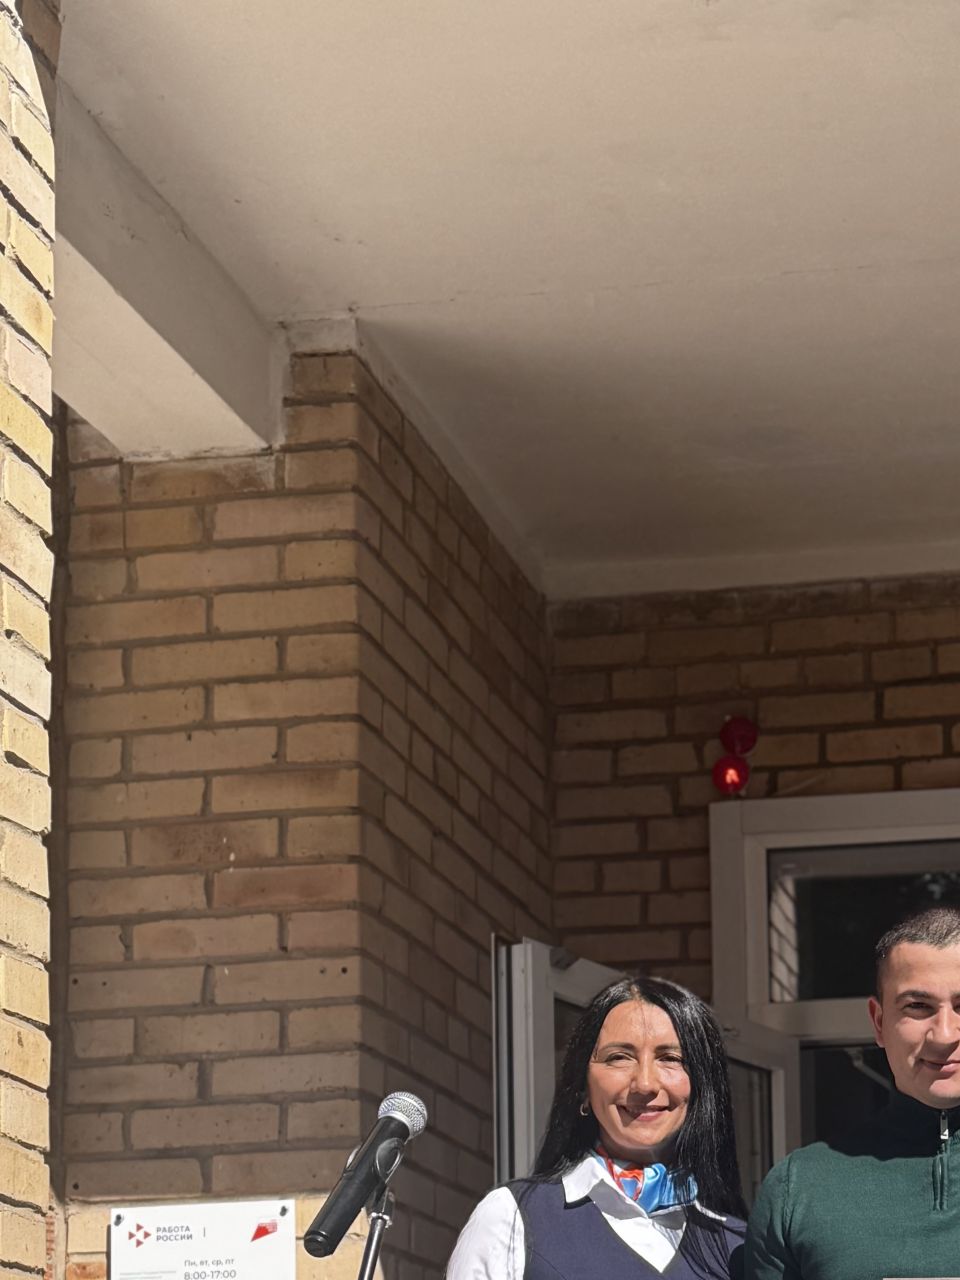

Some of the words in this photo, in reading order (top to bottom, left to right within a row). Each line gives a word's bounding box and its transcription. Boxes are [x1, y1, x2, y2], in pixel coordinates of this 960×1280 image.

[156, 1225, 191, 1233] РАБОТА
[156, 1234, 193, 1242] РОССИИ
[184, 1269, 237, 1280] 8:00-17:00
